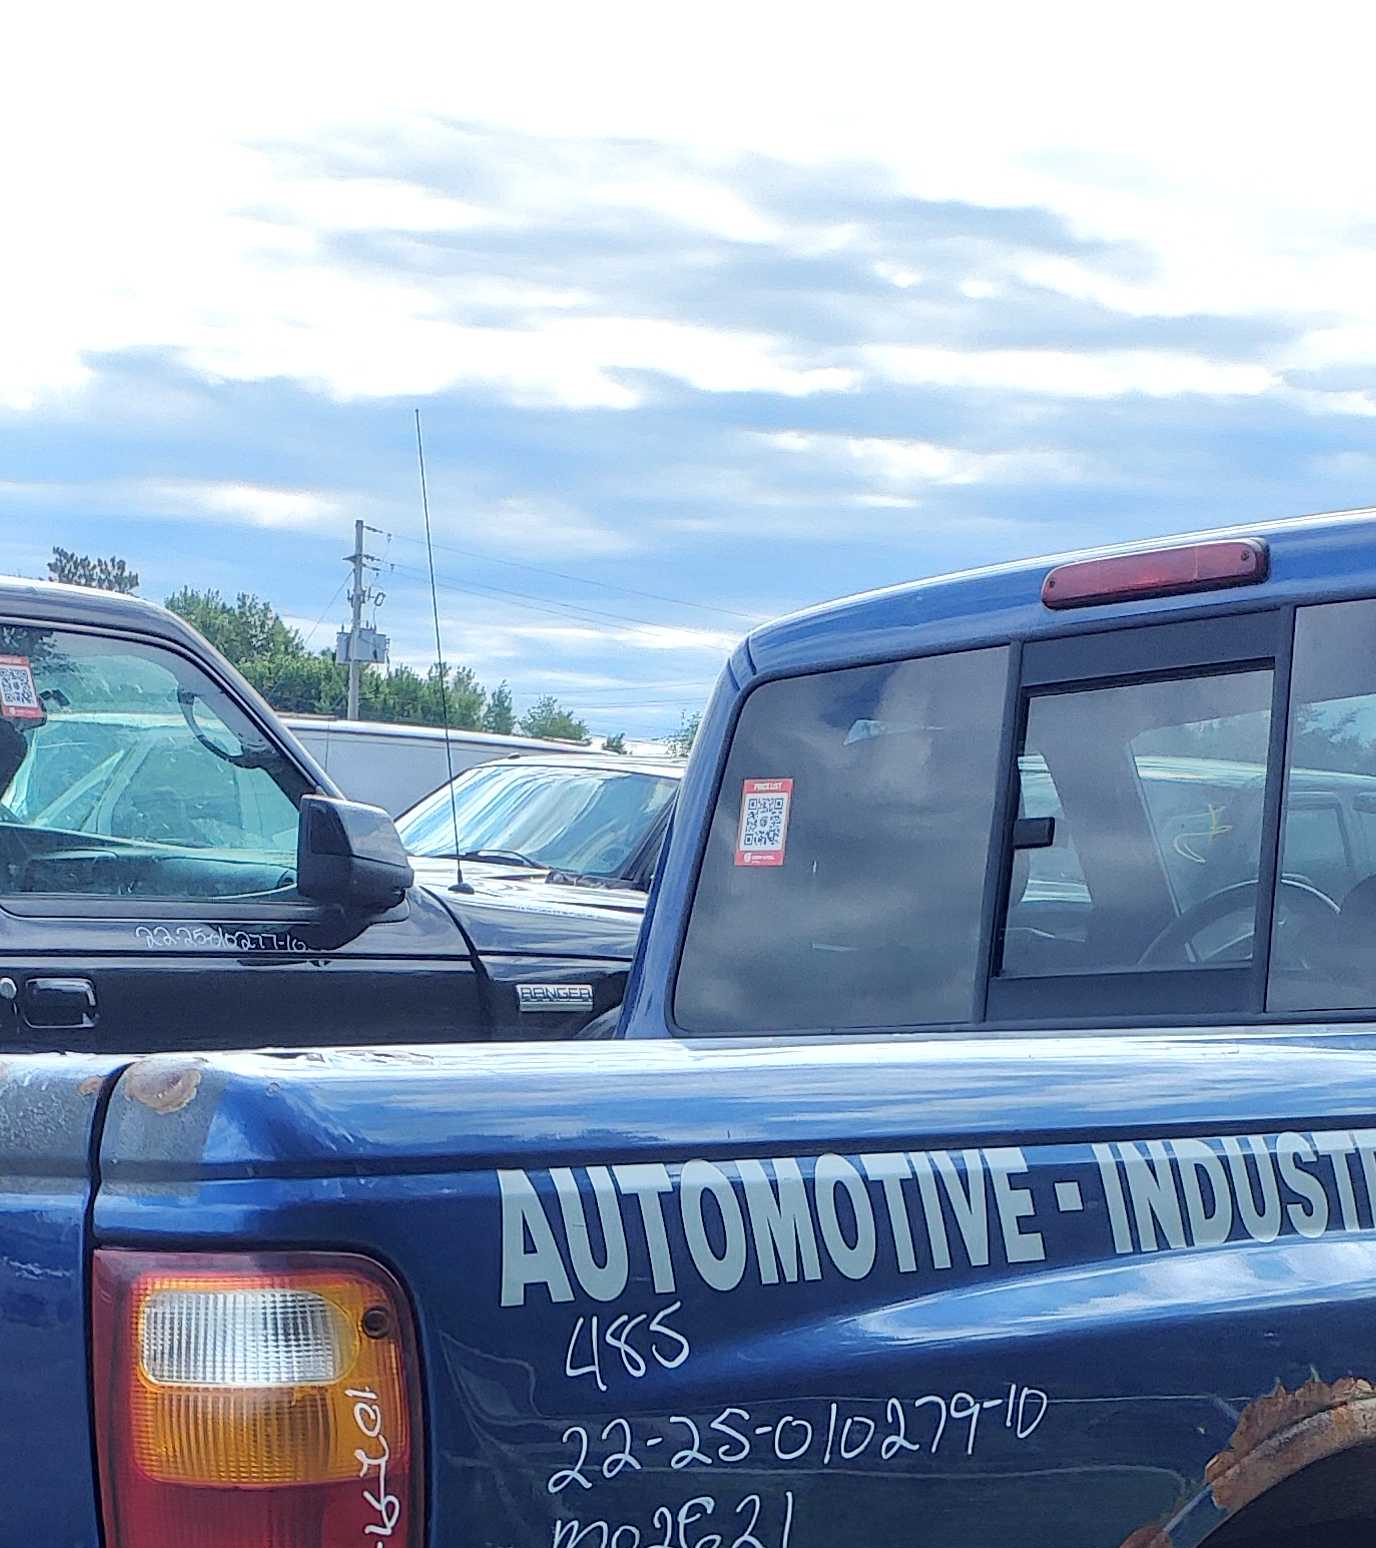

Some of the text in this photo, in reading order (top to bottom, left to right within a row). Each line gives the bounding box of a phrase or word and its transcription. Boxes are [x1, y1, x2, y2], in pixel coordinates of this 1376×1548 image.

[520, 987, 592, 1000] RANGER
[497, 1147, 1045, 1308] AUTOMOTIVE
[565, 1302, 691, 1391] 485
[547, 1384, 1048, 1494] 22-25-010279-10
